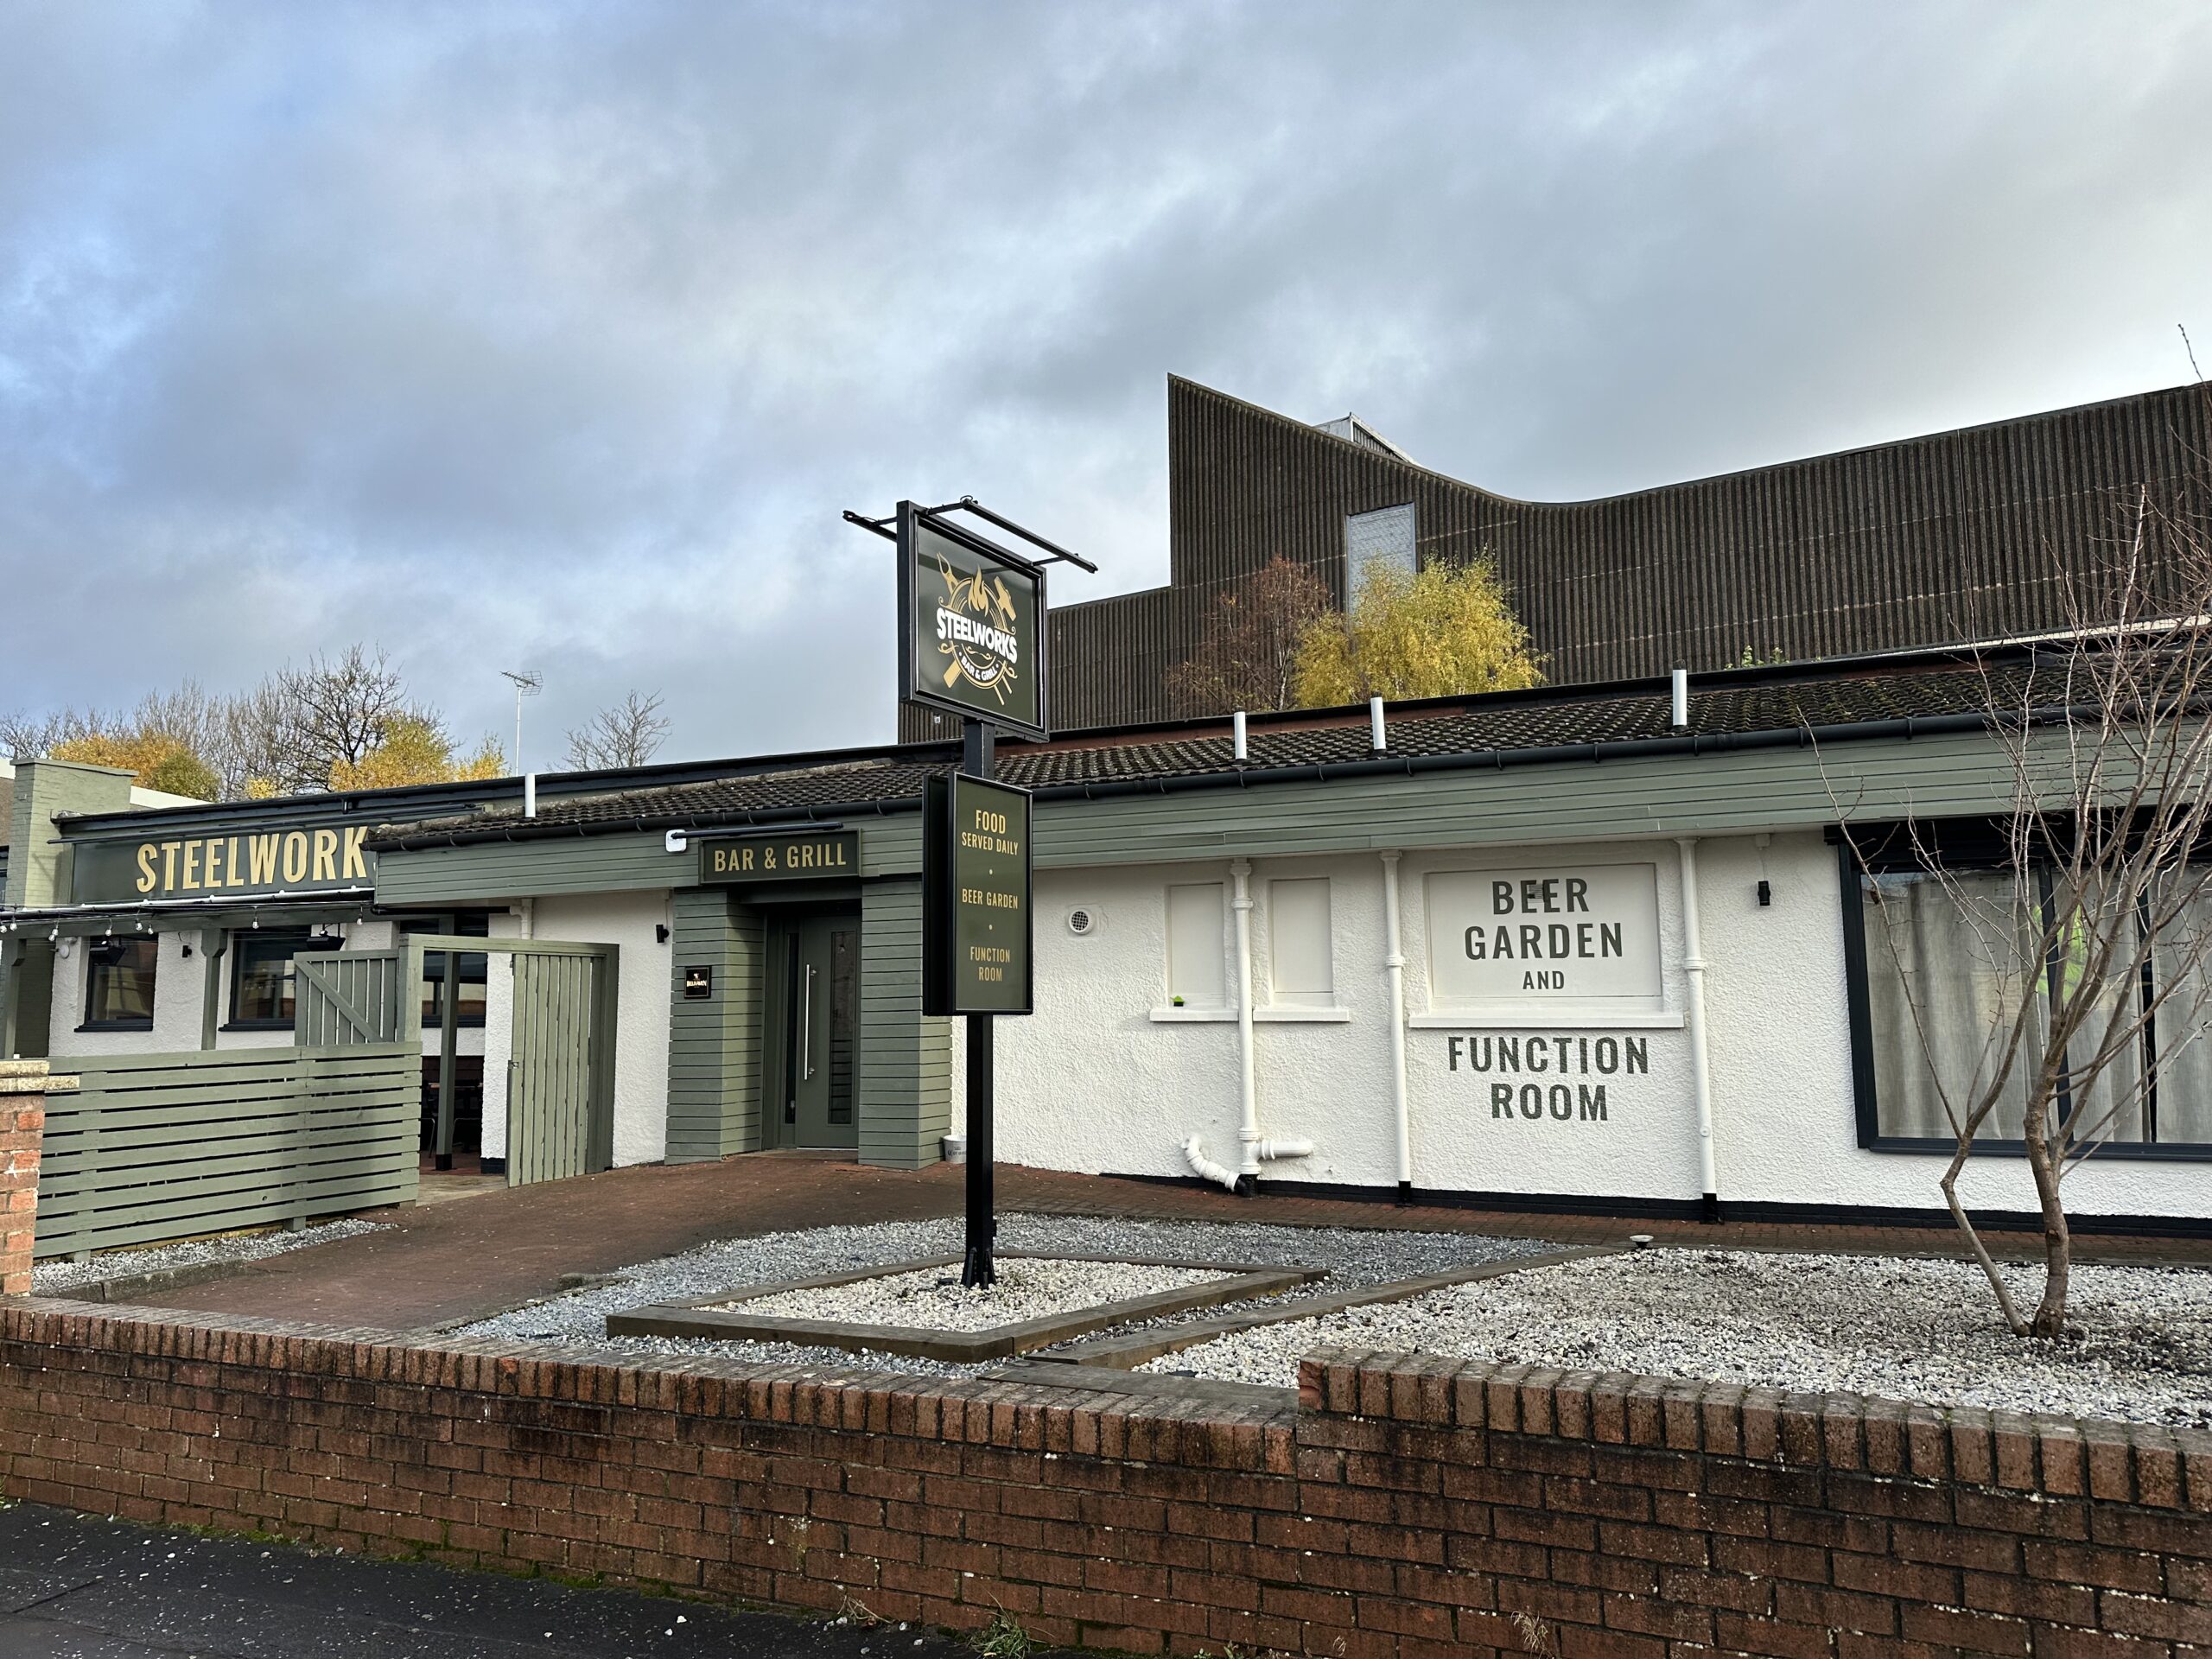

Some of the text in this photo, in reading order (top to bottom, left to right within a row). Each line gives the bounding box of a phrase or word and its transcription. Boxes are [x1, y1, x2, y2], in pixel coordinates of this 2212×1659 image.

[936, 607, 1018, 664] STEELWORKS
[961, 656, 998, 681] BAR & GRILL
[976, 810, 1006, 835] FOOD
[961, 831, 1019, 855] SERVED DAILY
[136, 826, 375, 893] STEELWORK
[714, 842, 847, 872] BAR & GRILL
[962, 887, 1019, 909] BEER GARDEN
[1492, 878, 1590, 915] BEER
[969, 946, 1011, 963] FUNCTION
[1465, 923, 1623, 960] GARDEN
[978, 966, 1002, 982] ROOM
[1522, 970, 1565, 989] AND
[1447, 1036, 1649, 1074] FUNCTION
[1491, 1084, 1608, 1122] ROOM
